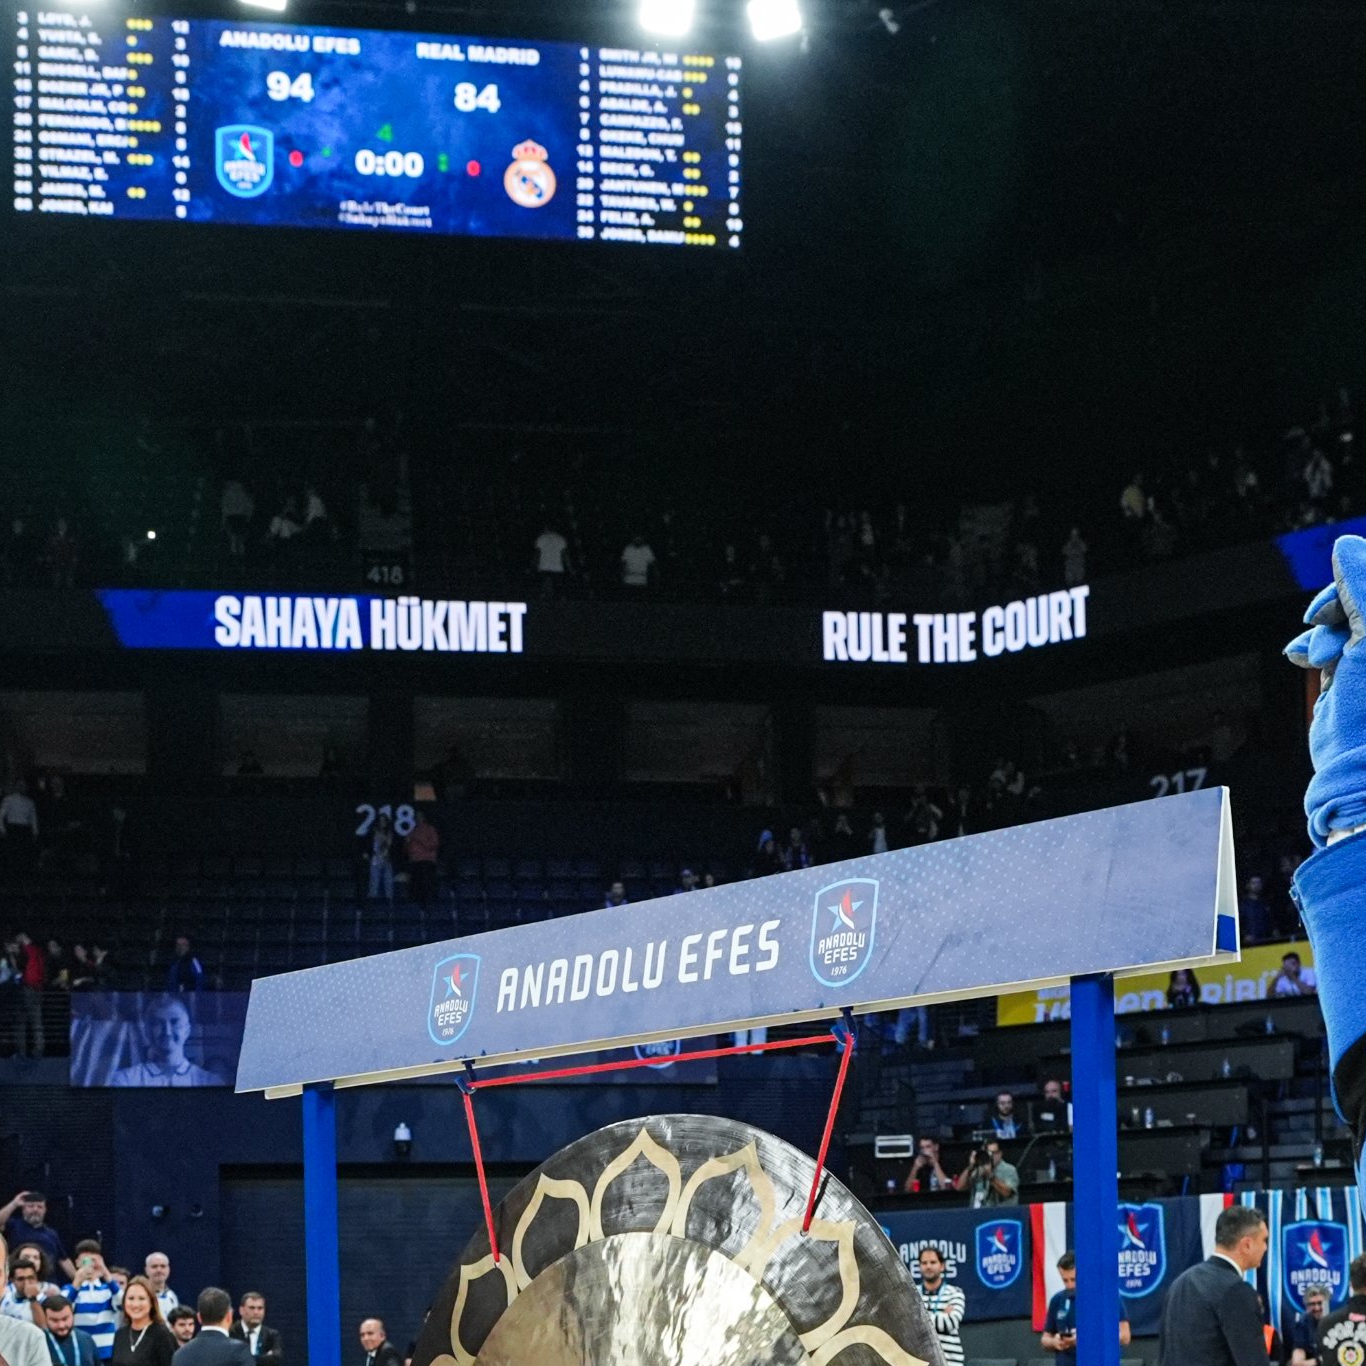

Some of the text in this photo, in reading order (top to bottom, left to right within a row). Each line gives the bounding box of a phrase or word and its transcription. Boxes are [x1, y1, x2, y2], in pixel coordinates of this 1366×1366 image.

[219, 30, 361, 55] ANADOLU EFES
[415, 42, 541, 66] REAL MADRID
[266, 71, 315, 103] 94
[453, 82, 501, 113] 84
[355, 149, 425, 178] 0:00
[214, 595, 527, 654] SAHAYA HÜKMET
[822, 584, 1090, 664] RULE THE COURT
[818, 931, 866, 955] ANADOLU
[496, 917, 782, 1013] ANADOLU EFES
[824, 946, 858, 965] EFES
[831, 965, 848, 976] 1976
[434, 999, 469, 1018] ANADOLU
[437, 1012, 462, 1026] EFES
[1118, 1250, 1157, 1264] NADOLU
[909, 1261, 957, 1278] ES
[1119, 1263, 1151, 1276] EFES
[1290, 1268, 1341, 1286] ANADOLU
[1297, 1282, 1334, 1297] ES
